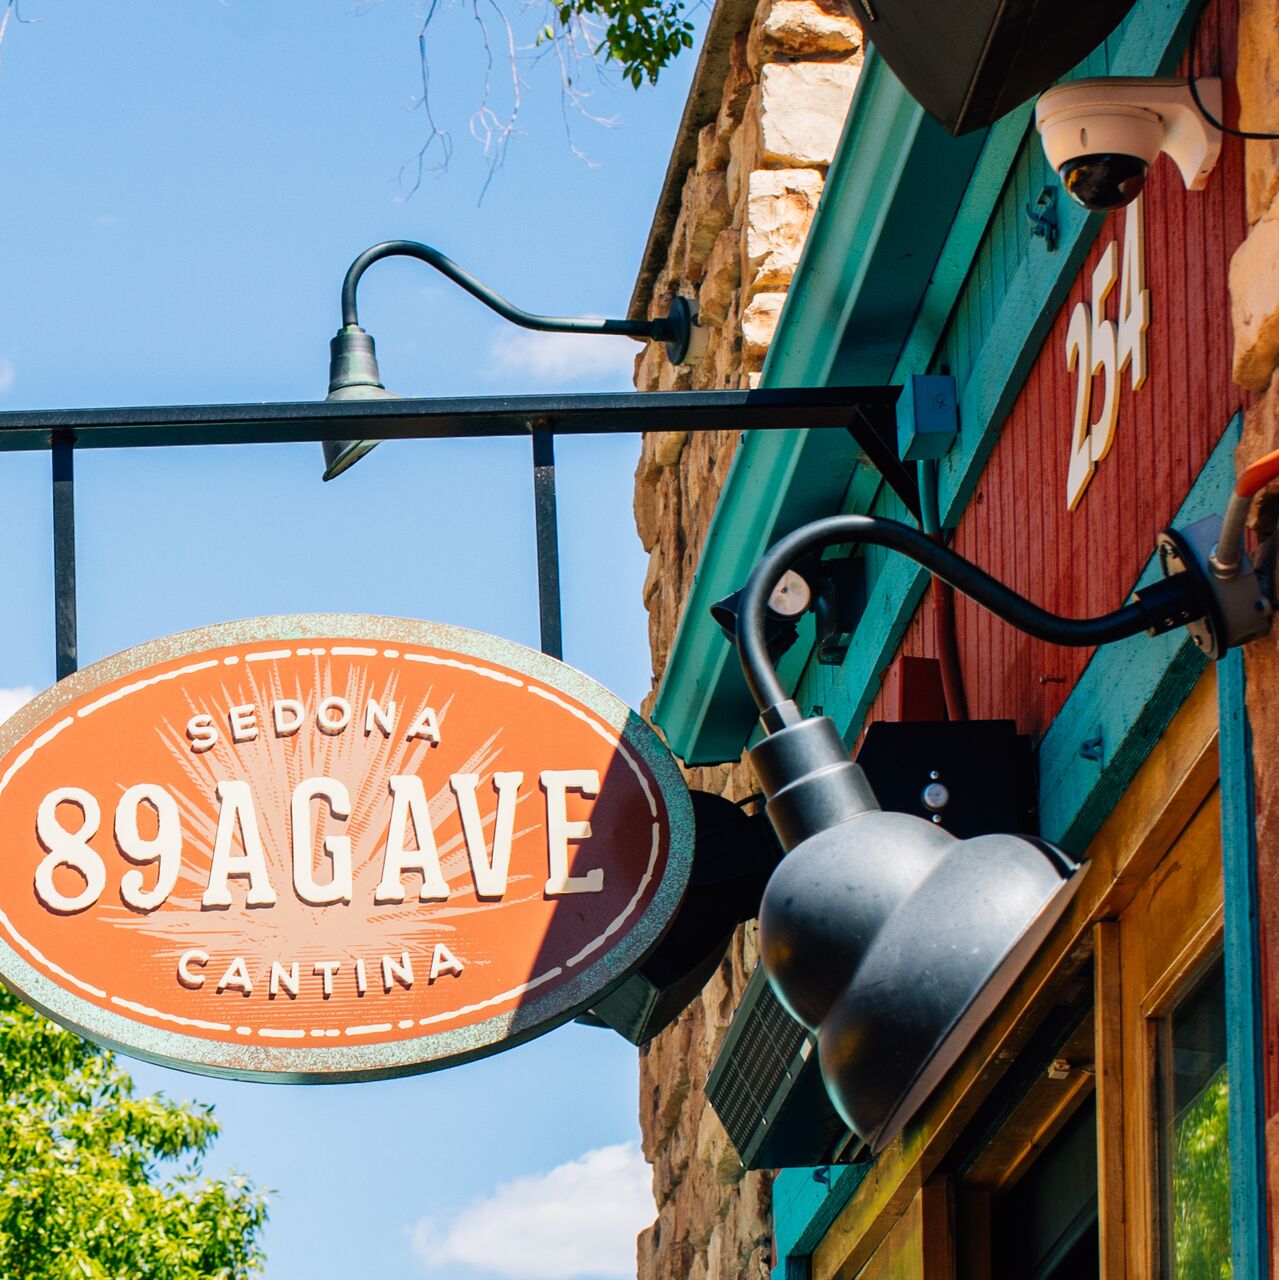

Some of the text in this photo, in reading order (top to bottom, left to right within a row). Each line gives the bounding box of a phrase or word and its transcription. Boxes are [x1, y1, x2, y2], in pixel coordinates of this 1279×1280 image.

[1066, 193, 1151, 513] 254
[186, 695, 442, 752] SEDONA
[177, 942, 465, 999] CANTINA
